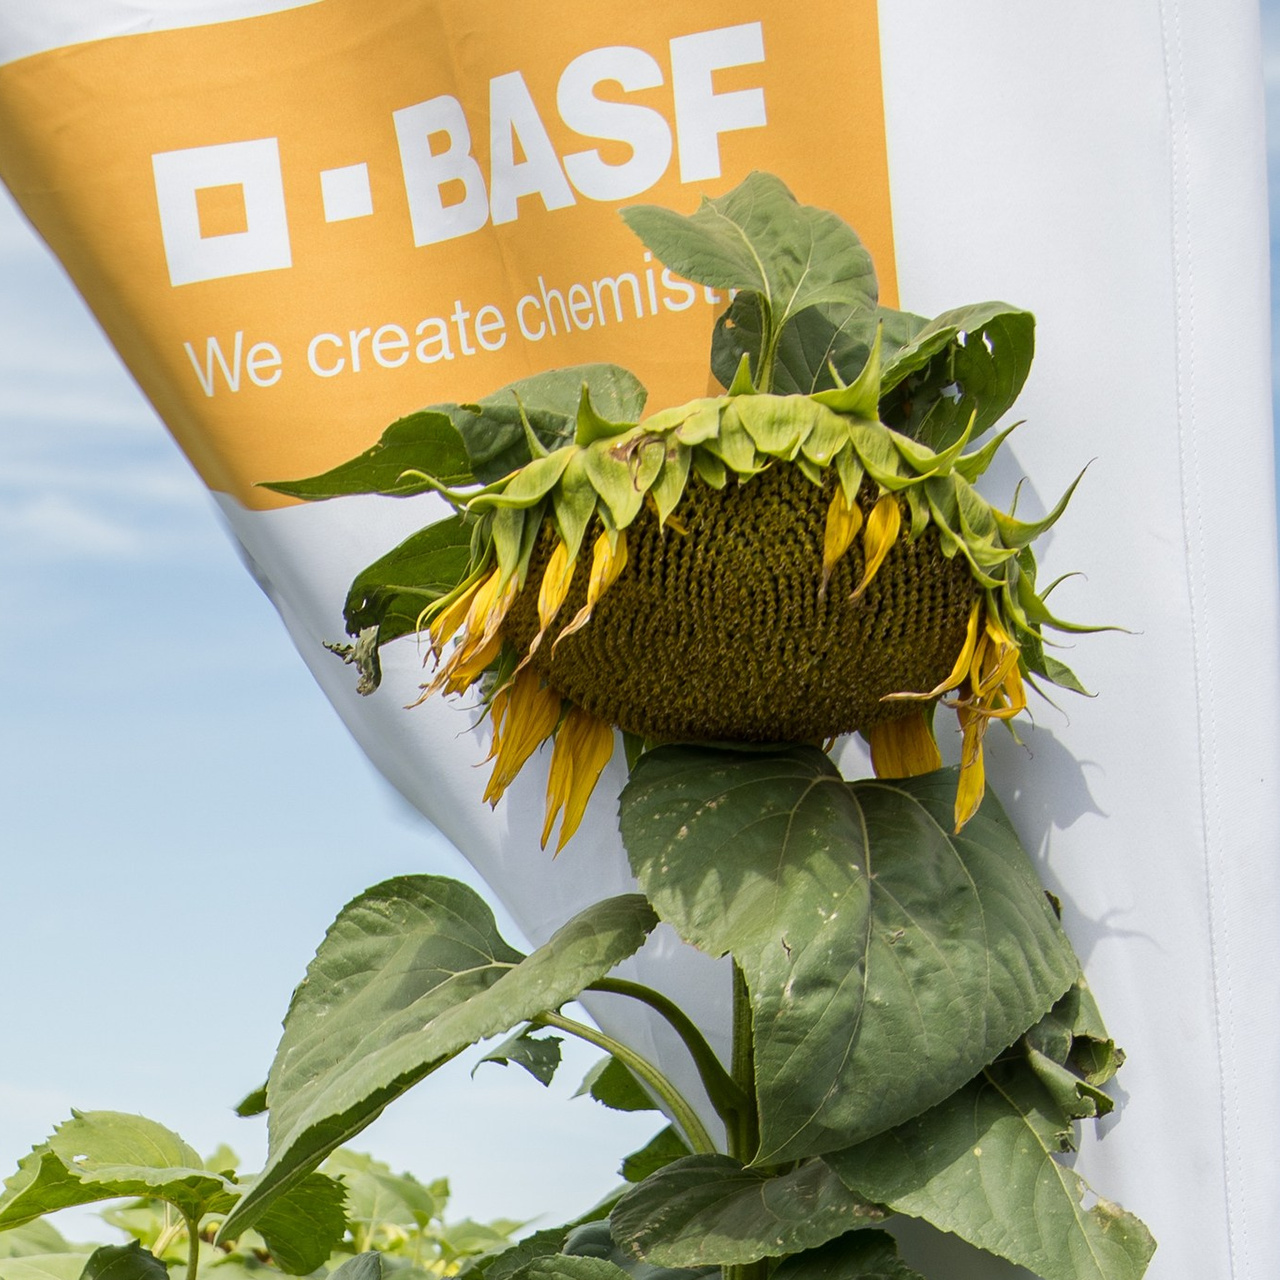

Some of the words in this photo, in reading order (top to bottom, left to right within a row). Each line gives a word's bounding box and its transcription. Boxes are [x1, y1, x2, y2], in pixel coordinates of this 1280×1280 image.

[392, 21, 767, 249] BASF
[184, 331, 282, 397] We
[307, 301, 506, 378] create
[516, 252, 738, 341] chemis
